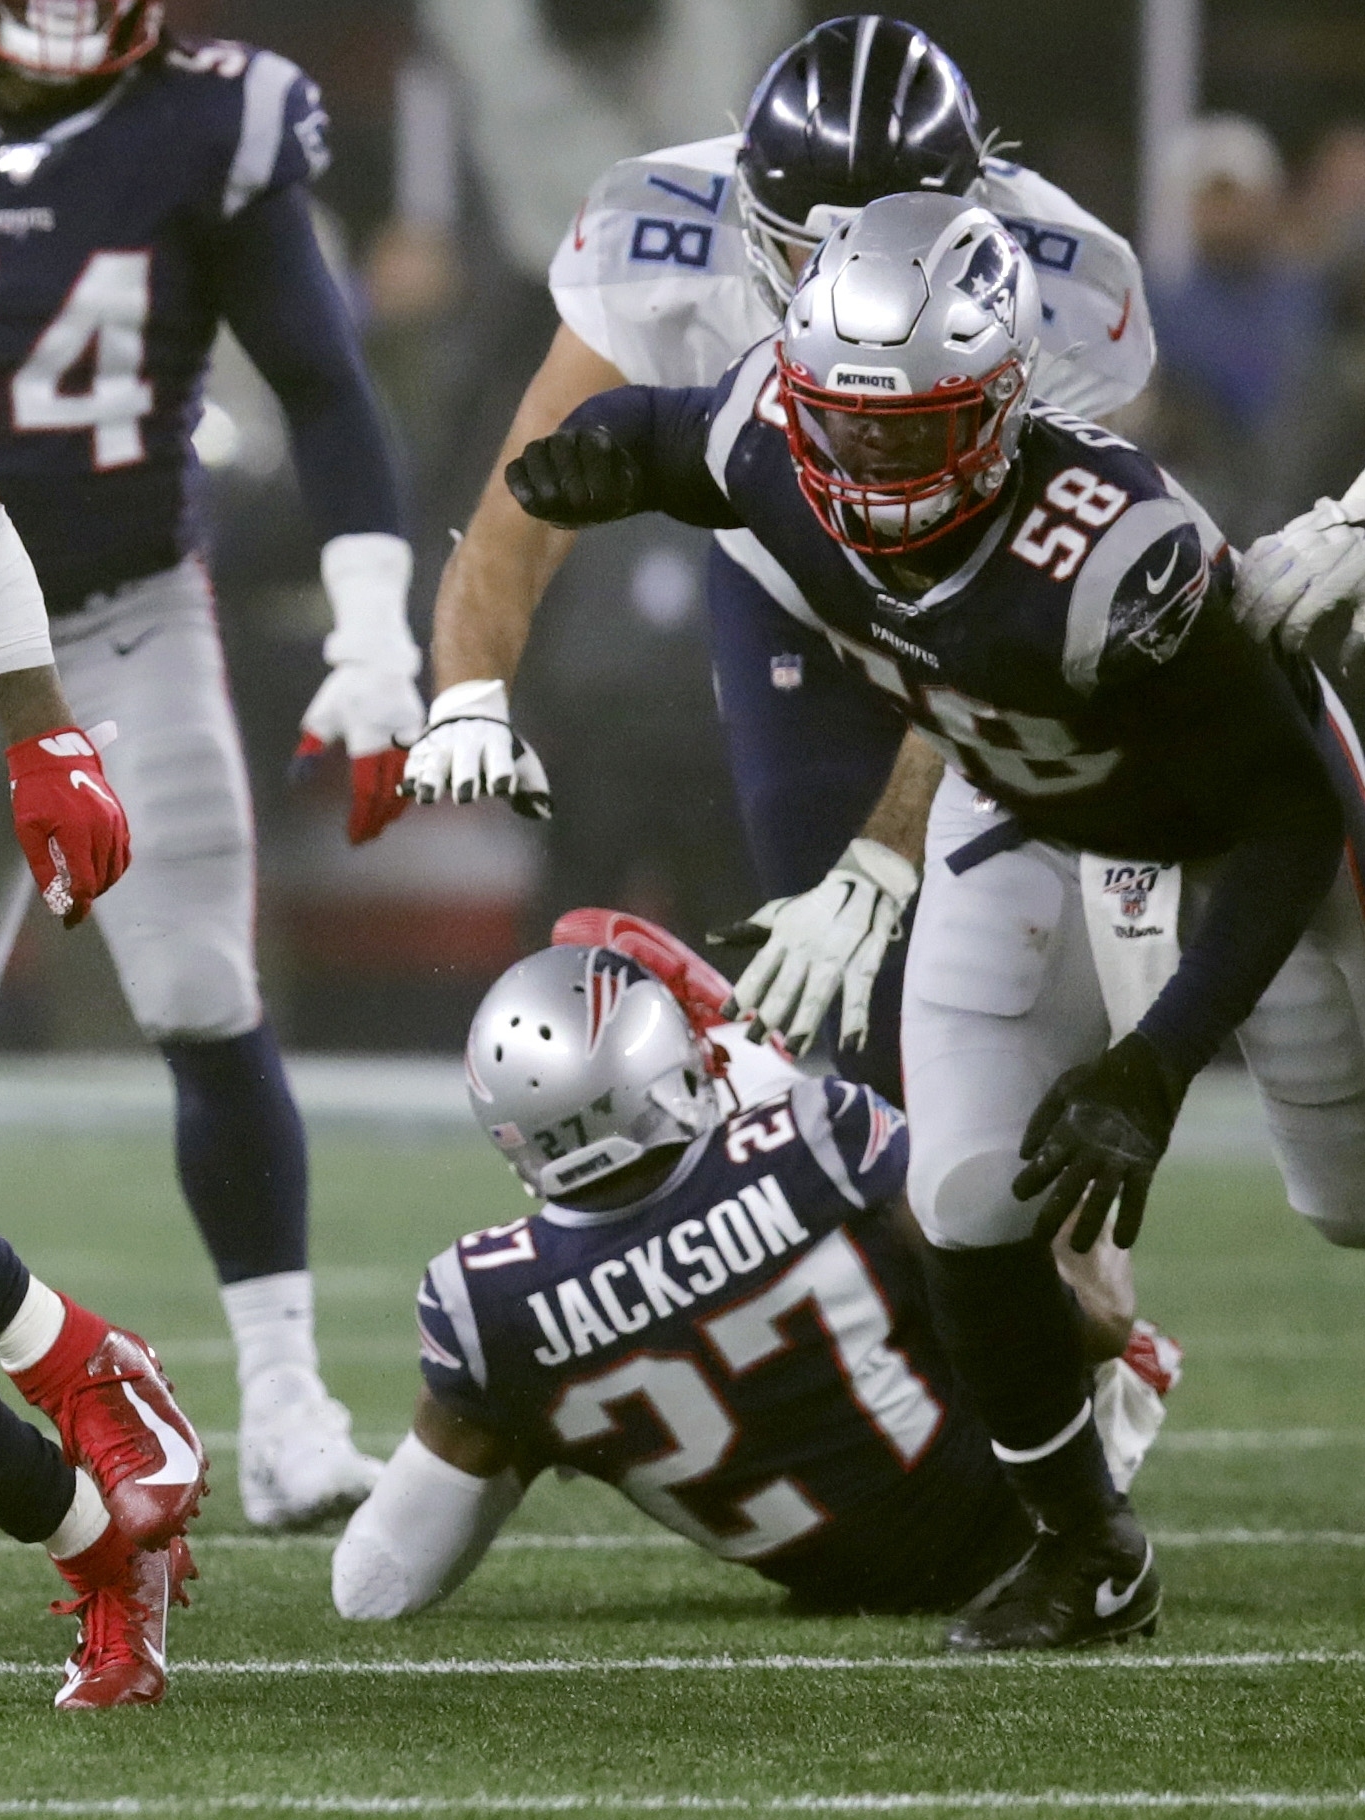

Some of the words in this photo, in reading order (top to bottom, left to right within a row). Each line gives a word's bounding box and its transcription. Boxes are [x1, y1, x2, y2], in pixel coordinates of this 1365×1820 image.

[629, 173, 727, 268] 78
[837, 371, 897, 391] PATRIOTS
[1010, 466, 1130, 582] 58
[534, 1112, 590, 1161] 27
[459, 1215, 538, 1271] 27
[526, 1173, 811, 1368] JACKSON
[546, 1224, 948, 1561] 27
